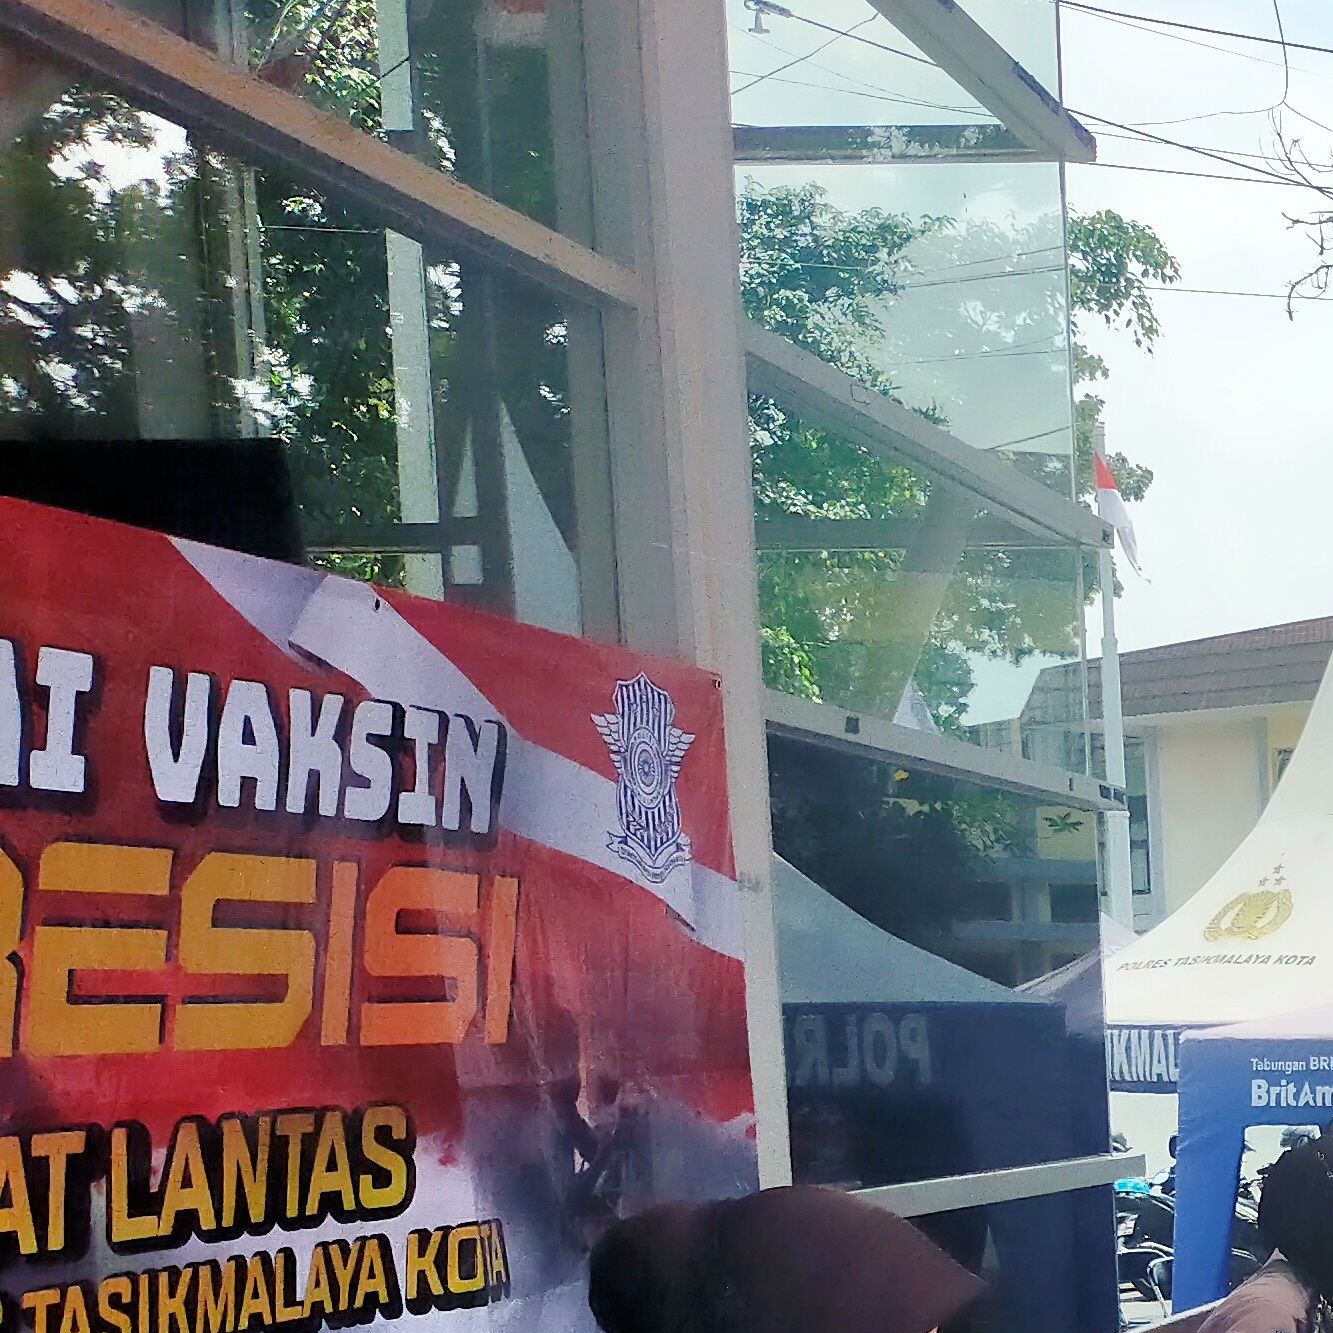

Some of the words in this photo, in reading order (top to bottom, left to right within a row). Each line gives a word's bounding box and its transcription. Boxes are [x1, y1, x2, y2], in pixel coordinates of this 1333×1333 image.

[145, 665, 501, 834] VAKSIN
[0, 840, 520, 1058] ESISI
[1273, 955, 1317, 966] KOTA
[1251, 1057, 1306, 1074] Tabungan
[1309, 1056, 1333, 1071] BRI
[110, 1105, 407, 1243] LANTAS
[406, 1220, 507, 1300] KOTA
